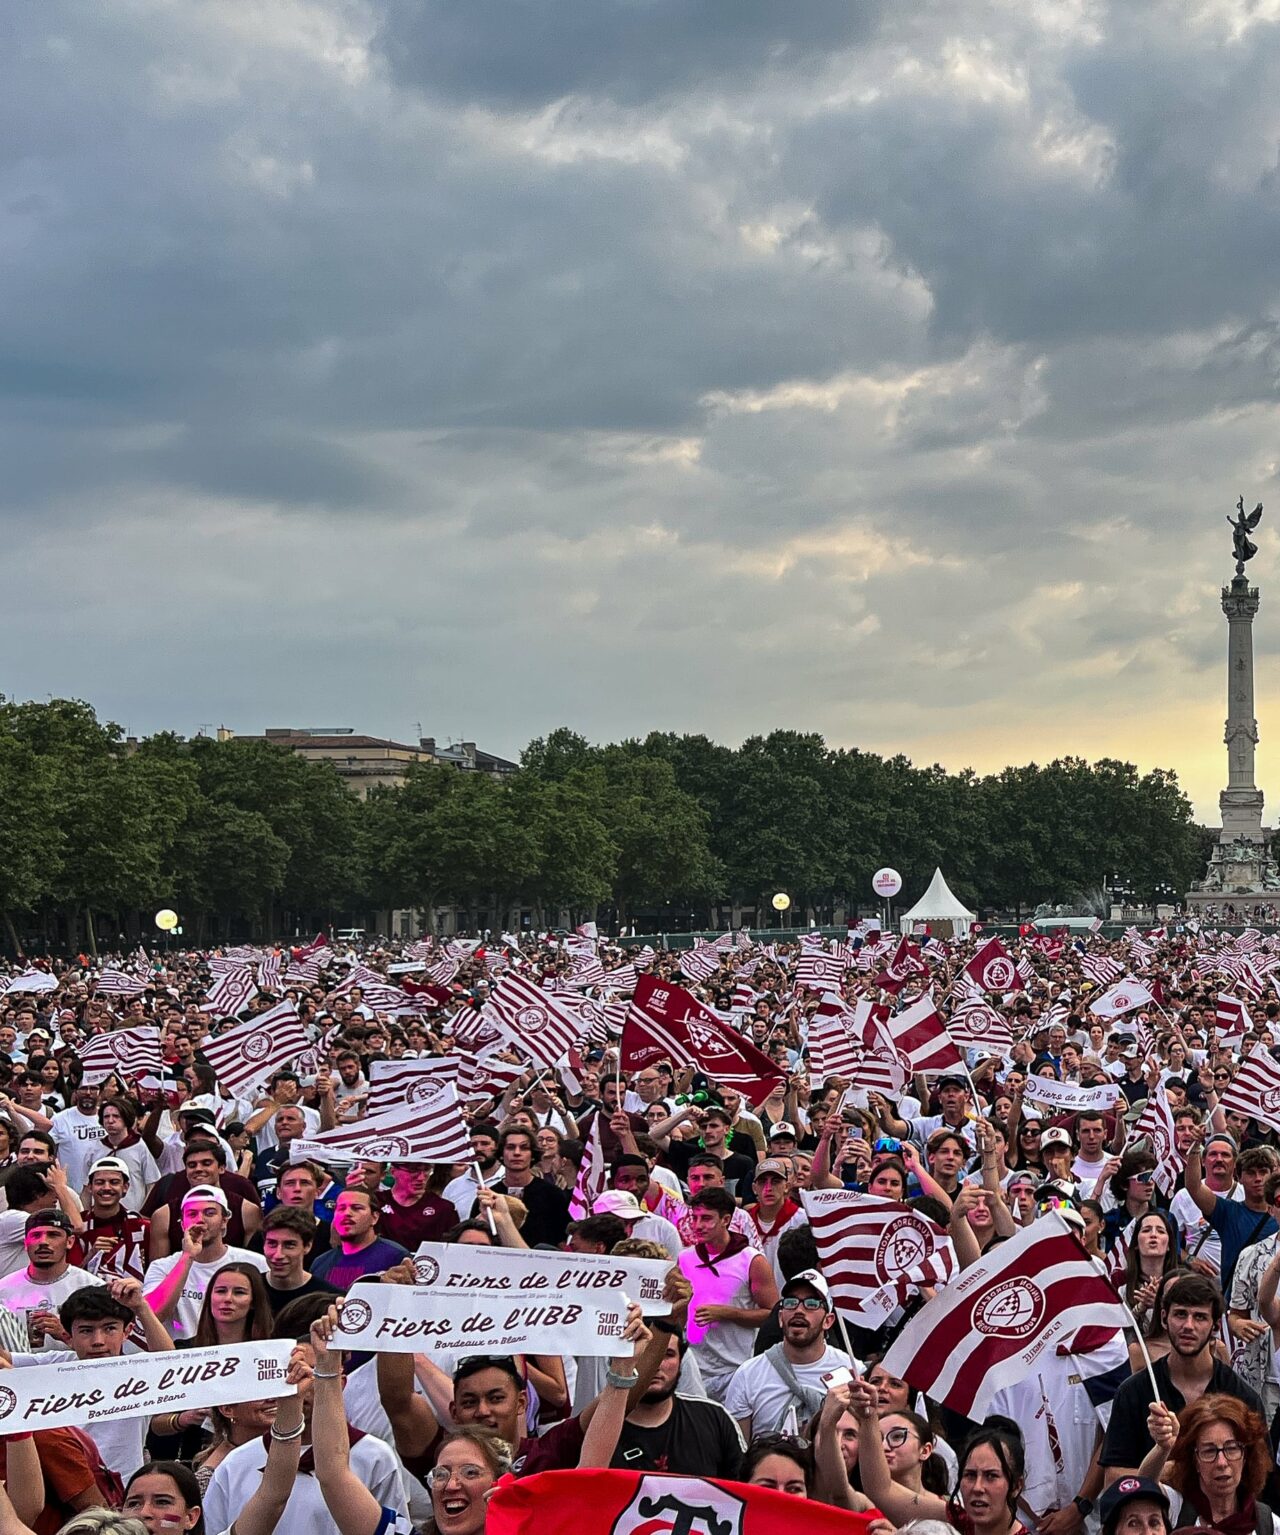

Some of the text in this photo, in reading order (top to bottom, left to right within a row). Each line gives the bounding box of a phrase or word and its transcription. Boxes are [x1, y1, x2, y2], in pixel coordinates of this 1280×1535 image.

[1065, 1093, 1076, 1101] de
[878, 1217, 931, 1266] UNION BORDEAUX
[519, 1271, 550, 1289] de
[556, 1268, 628, 1289] l'UBB
[641, 1278, 659, 1289] SUD
[640, 1288, 664, 1300] OUES
[375, 1304, 583, 1339] Fiers de l'UBB
[599, 1312, 619, 1325] SUD
[597, 1325, 624, 1336] OUES
[434, 1334, 527, 1350] Bordeaux en Blanc
[258, 1359, 278, 1370] SUD
[258, 1368, 289, 1381] OUEST
[23, 1389, 105, 1420] Fiers
[114, 1377, 149, 1399] de
[158, 1357, 241, 1391] l'UBB
[88, 1392, 187, 1420] Bordeaux en Blanc
